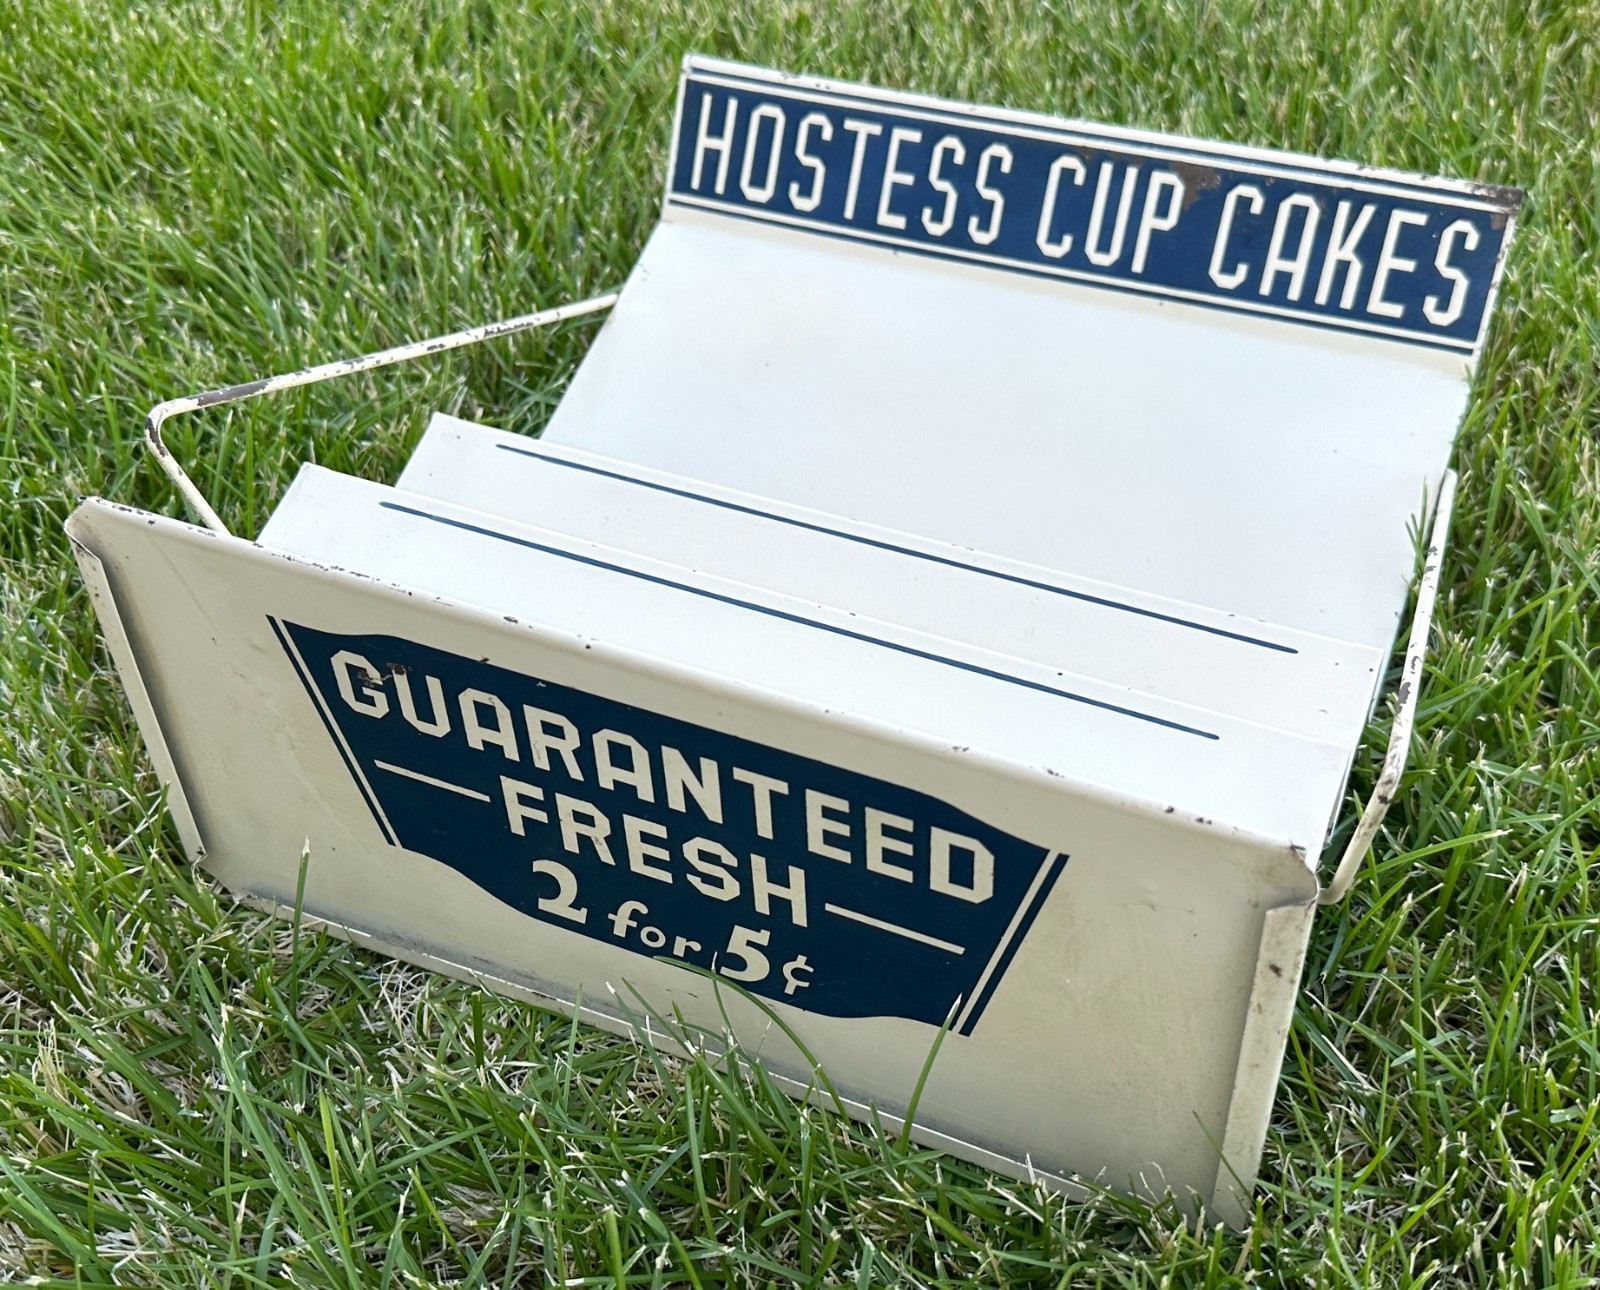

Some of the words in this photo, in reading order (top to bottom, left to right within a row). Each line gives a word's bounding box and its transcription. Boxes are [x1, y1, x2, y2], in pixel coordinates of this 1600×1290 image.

[691, 92, 1014, 245] HOSTESS
[1036, 154, 1186, 274] CUP
[1207, 184, 1479, 327] CAKES
[330, 650, 995, 905] GUARANTEED
[499, 774, 808, 928] FRESH
[531, 859, 589, 925] 2
[607, 900, 703, 959] for
[719, 925, 815, 996] 5¢
